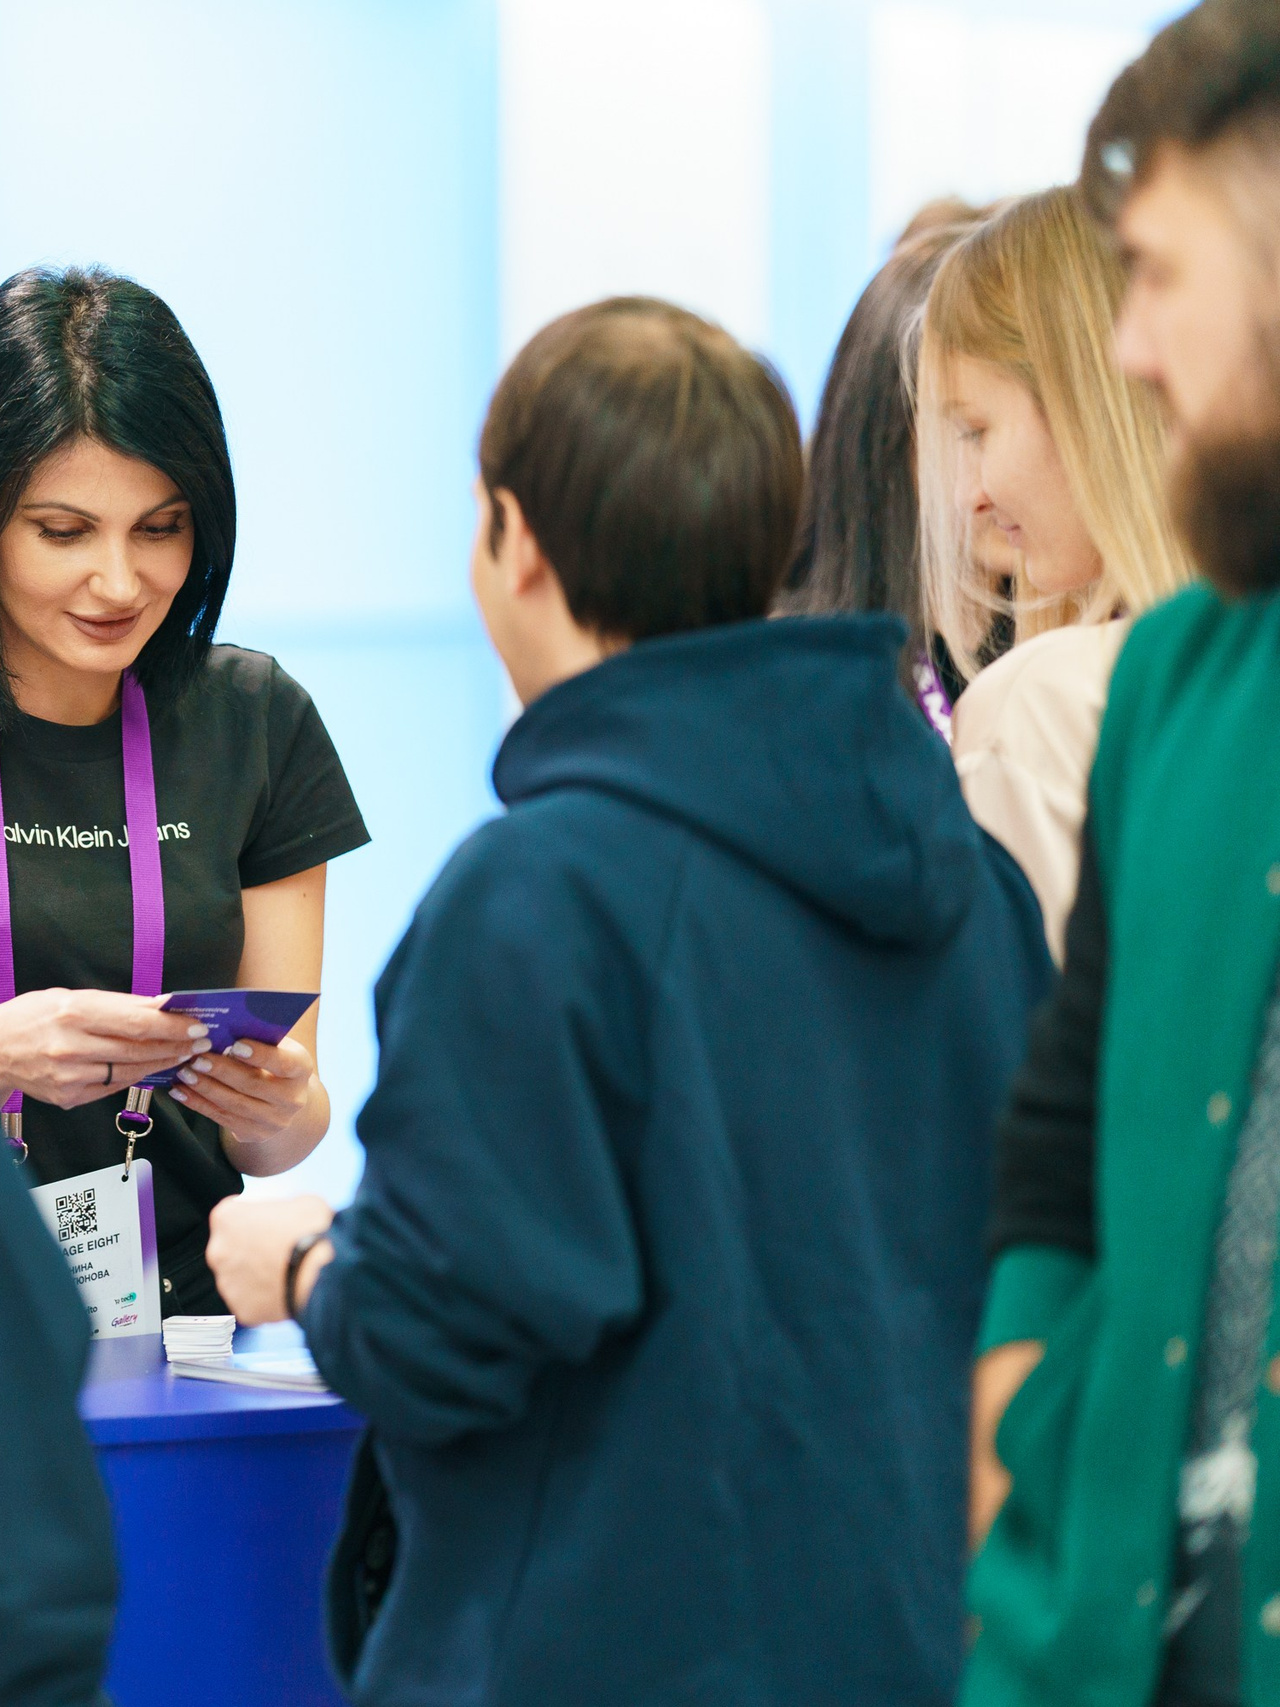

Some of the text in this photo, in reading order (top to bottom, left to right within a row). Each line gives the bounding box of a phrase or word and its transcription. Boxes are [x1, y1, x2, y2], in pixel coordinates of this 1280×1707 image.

[3, 821, 191, 849] alvin Klein Jns
[62, 1233, 121, 1257] AGE EIGHT
[70, 1261, 94, 1275] НИНА
[74, 1269, 110, 1286] ЮНОВА
[86, 1304, 98, 1315] ito
[111, 1312, 138, 1328] Gallery
